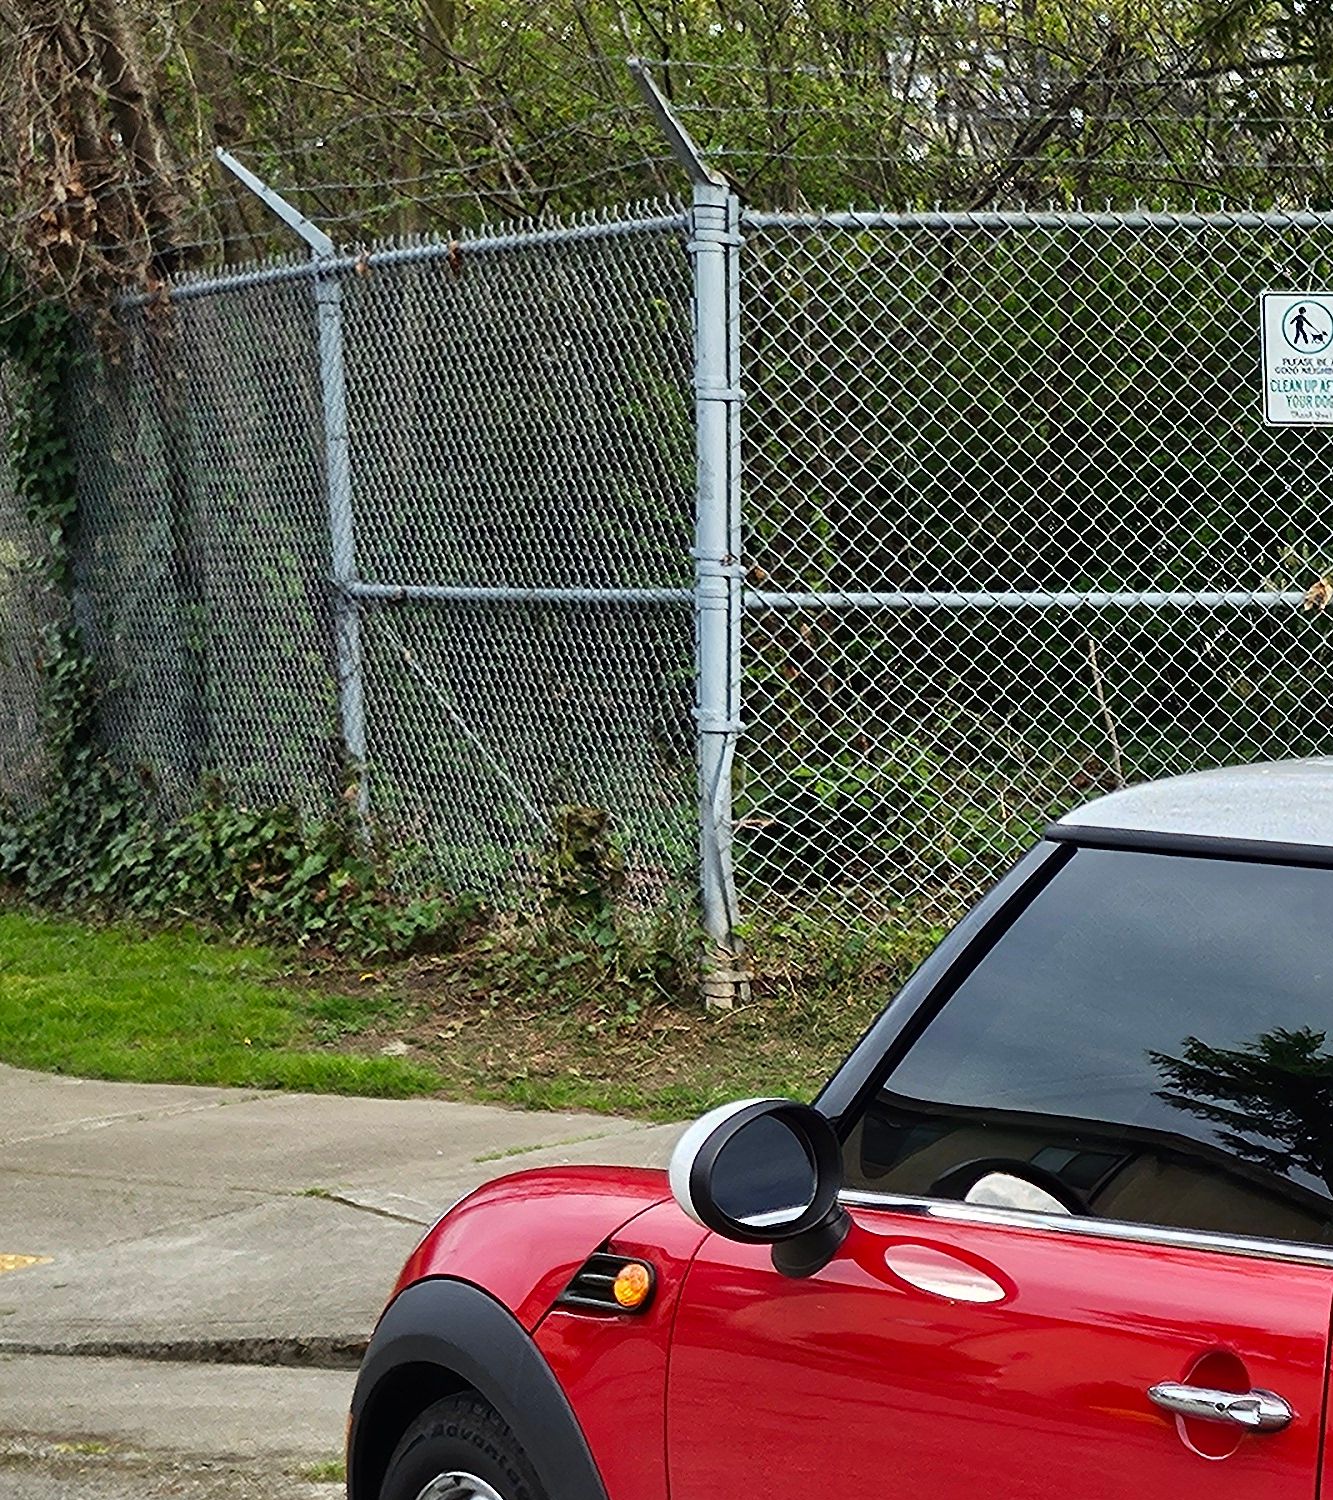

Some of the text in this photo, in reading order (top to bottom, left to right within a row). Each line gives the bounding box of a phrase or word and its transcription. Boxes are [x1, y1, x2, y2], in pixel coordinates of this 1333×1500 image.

[1282, 358, 1314, 367] PLEASE
[1317, 358, 1328, 367] BE
[1275, 366, 1299, 375] GOOD
[1270, 379, 1302, 393] CLEAN
[1304, 379, 1318, 393] UP
[1286, 394, 1313, 409] YOUR
